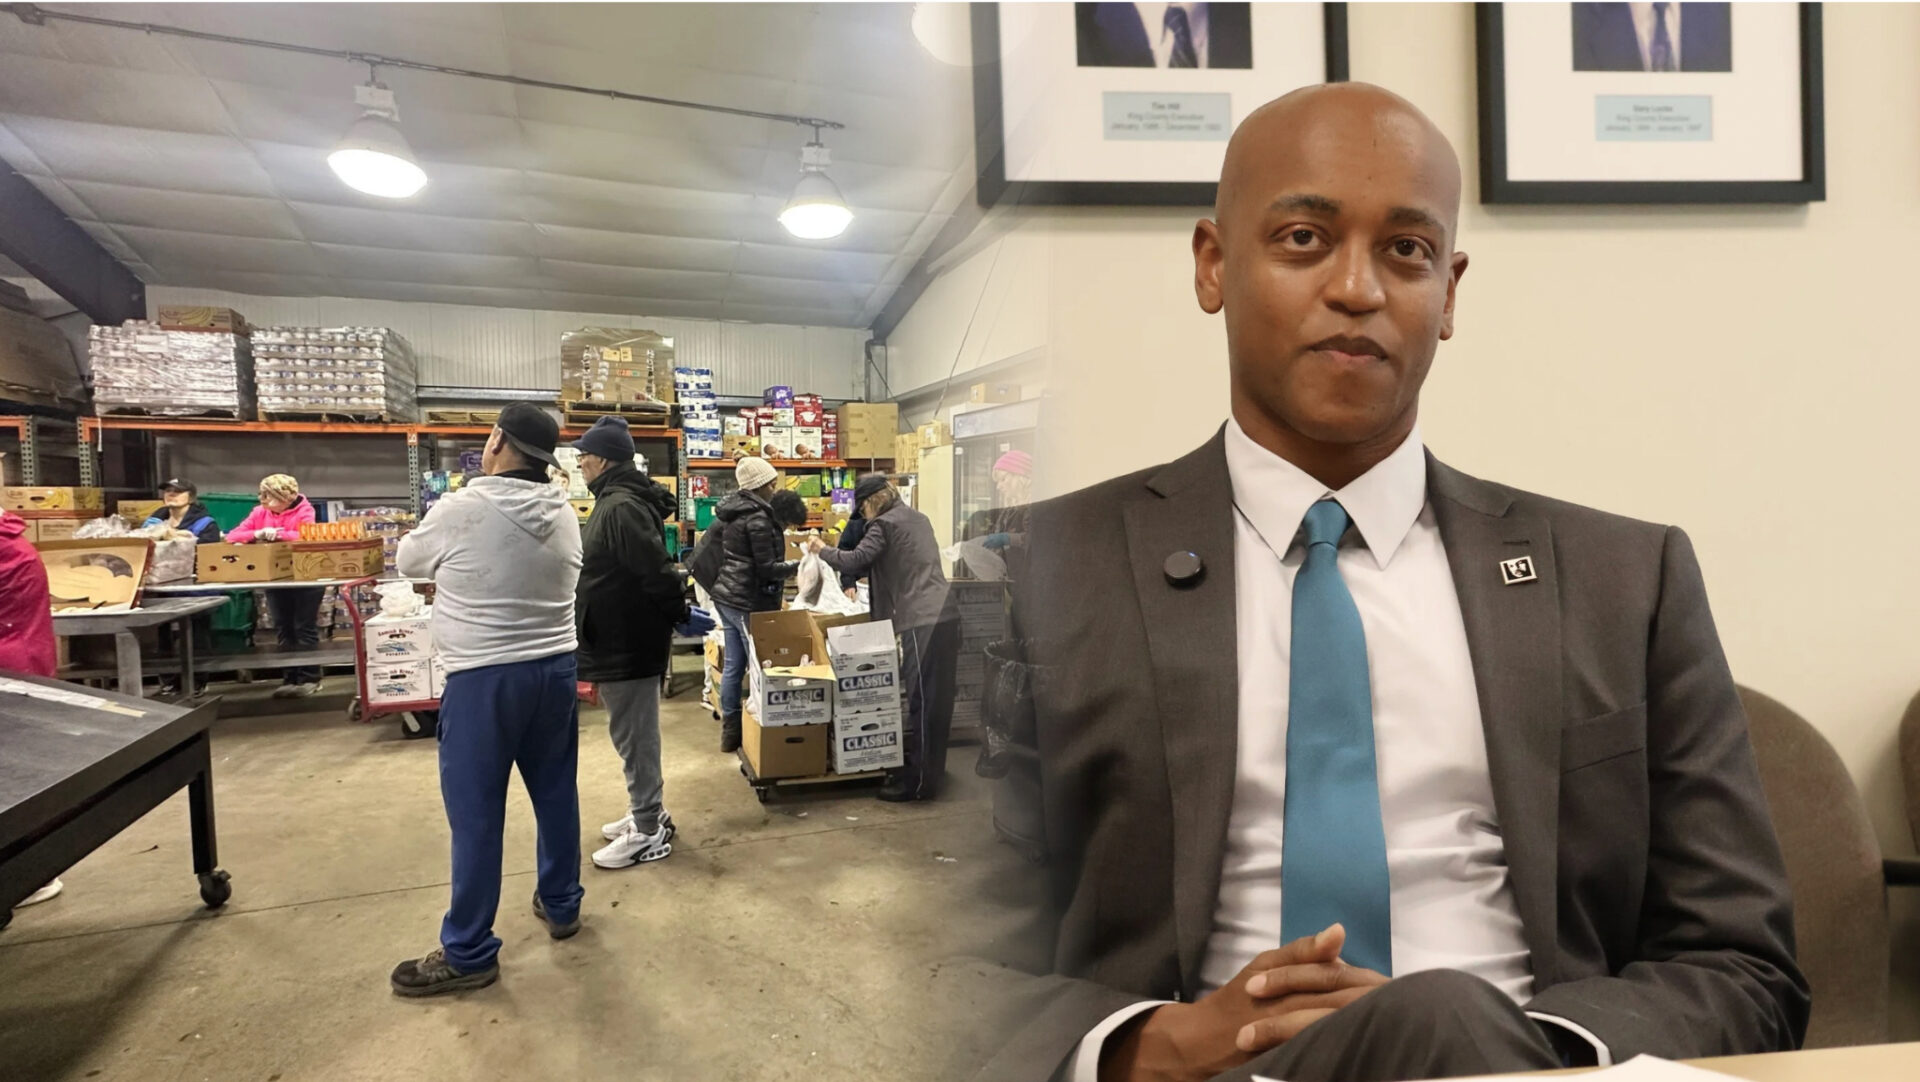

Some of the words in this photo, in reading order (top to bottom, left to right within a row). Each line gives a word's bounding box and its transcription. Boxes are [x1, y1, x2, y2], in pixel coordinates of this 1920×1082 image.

[841, 673, 891, 691] CLASSIC
[770, 689, 823, 704] CLASSIC
[846, 733, 895, 750] CLASSIC
